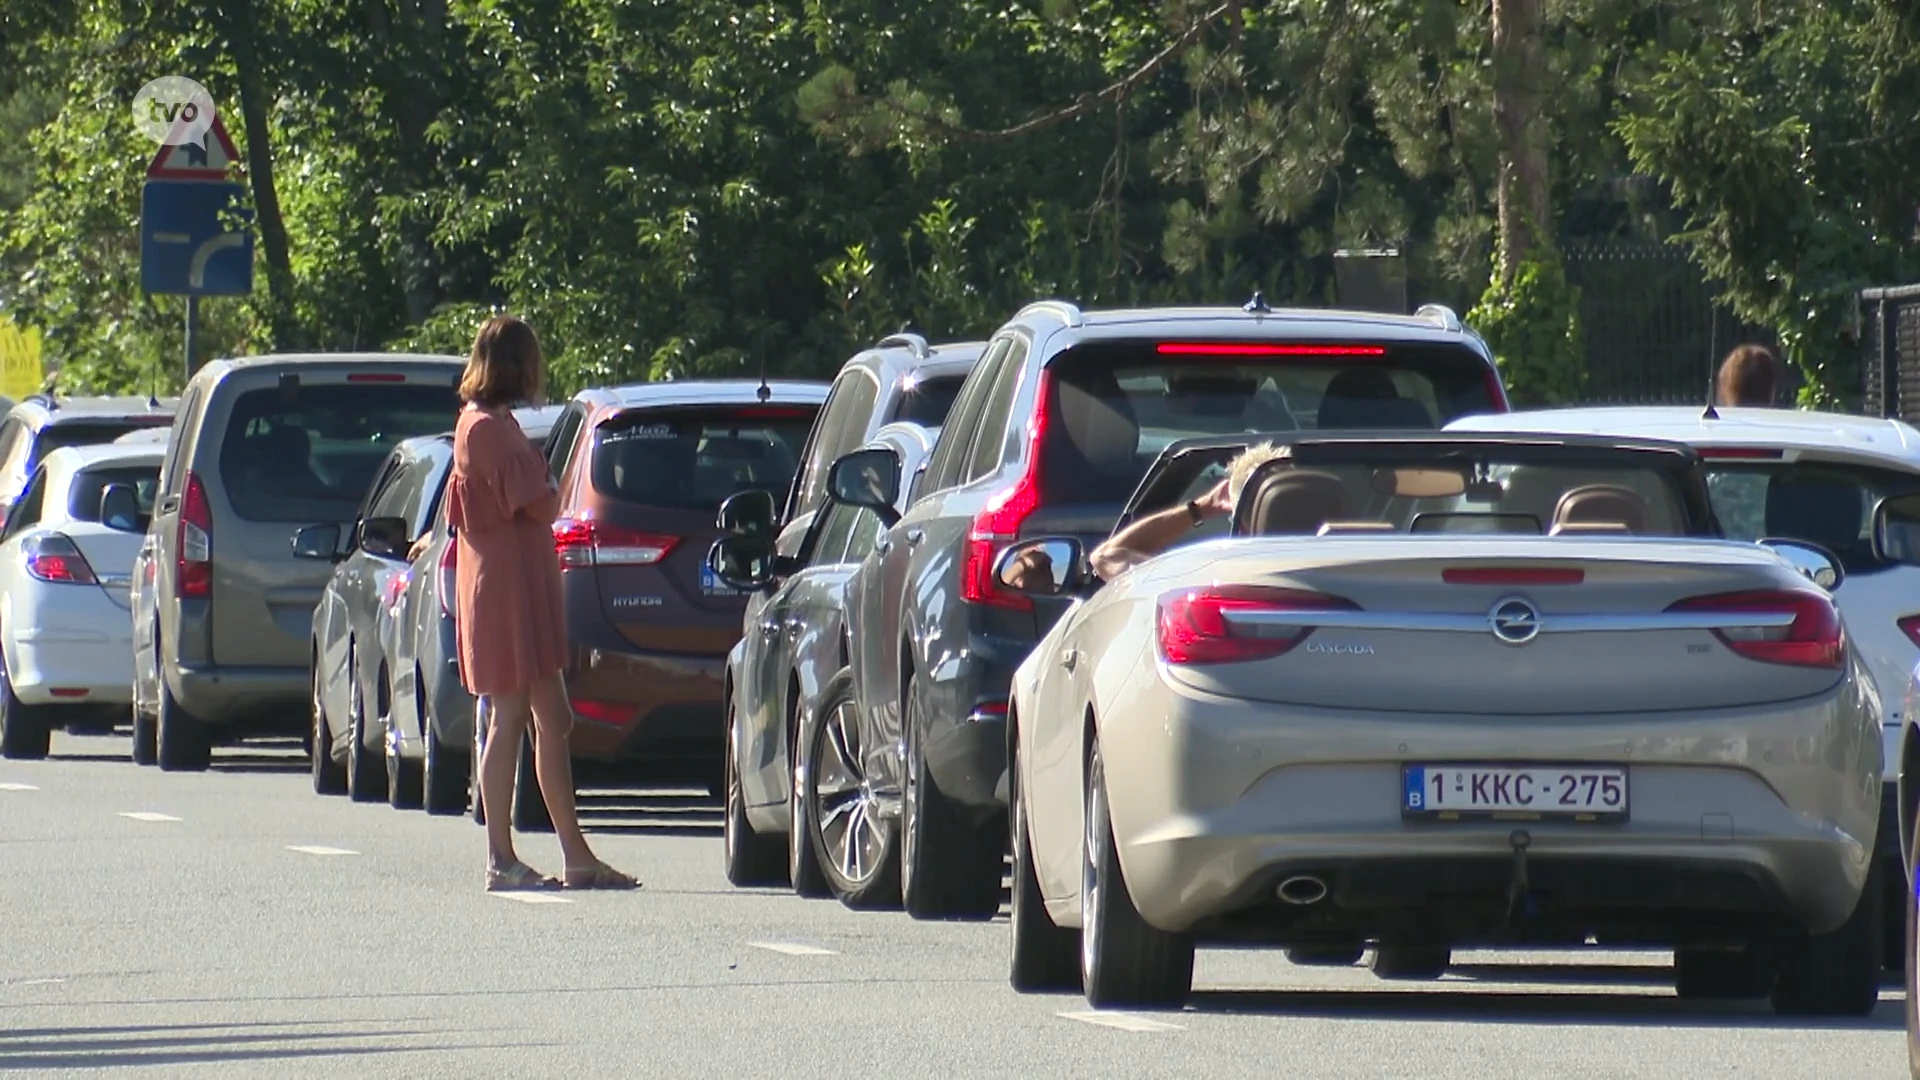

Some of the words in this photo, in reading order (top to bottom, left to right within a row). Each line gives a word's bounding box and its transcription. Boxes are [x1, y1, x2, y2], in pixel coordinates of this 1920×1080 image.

[703, 575, 712, 586] B
[613, 596, 662, 606] HYUNDAI
[1306, 643, 1375, 655] CASCADA
[1409, 793, 1421, 806] B
